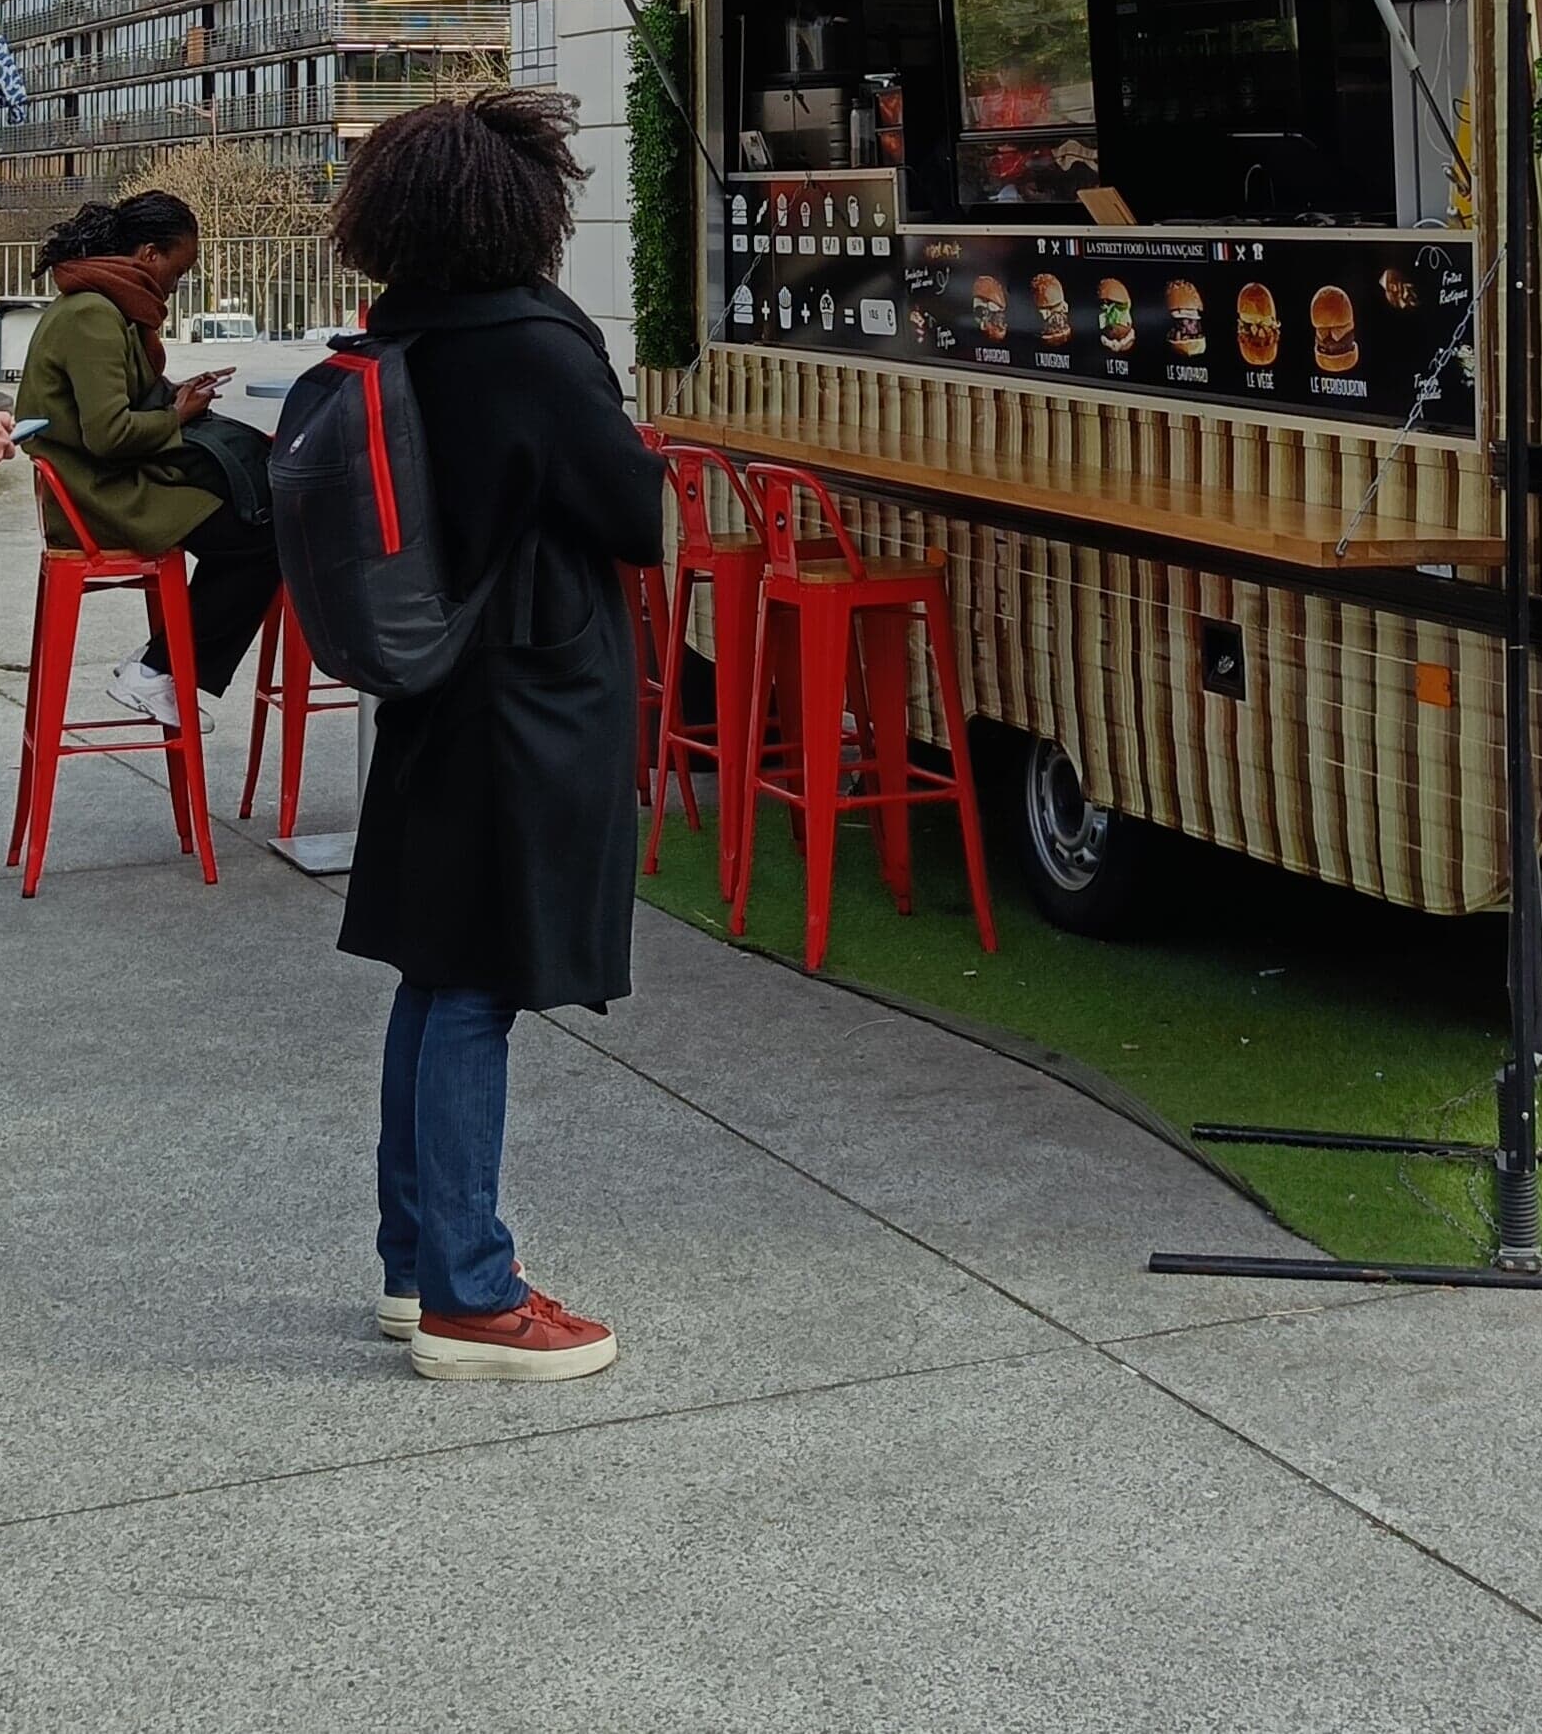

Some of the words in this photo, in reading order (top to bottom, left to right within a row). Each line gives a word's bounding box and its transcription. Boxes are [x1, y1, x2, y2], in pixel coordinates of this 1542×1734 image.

[1086, 242, 1097, 253] LA
[1097, 242, 1122, 254] STREET
[1123, 243, 1144, 255] FOOD
[1151, 244, 1161, 255] LA
[1162, 244, 1204, 258] FRANÇAISE
[1107, 359, 1114, 374] LE
[1115, 360, 1128, 375] FISH
[1167, 365, 1175, 380] LE
[1246, 371, 1256, 388] LE
[1258, 372, 1274, 390] VÉGÉ
[1310, 376, 1319, 393] LE
